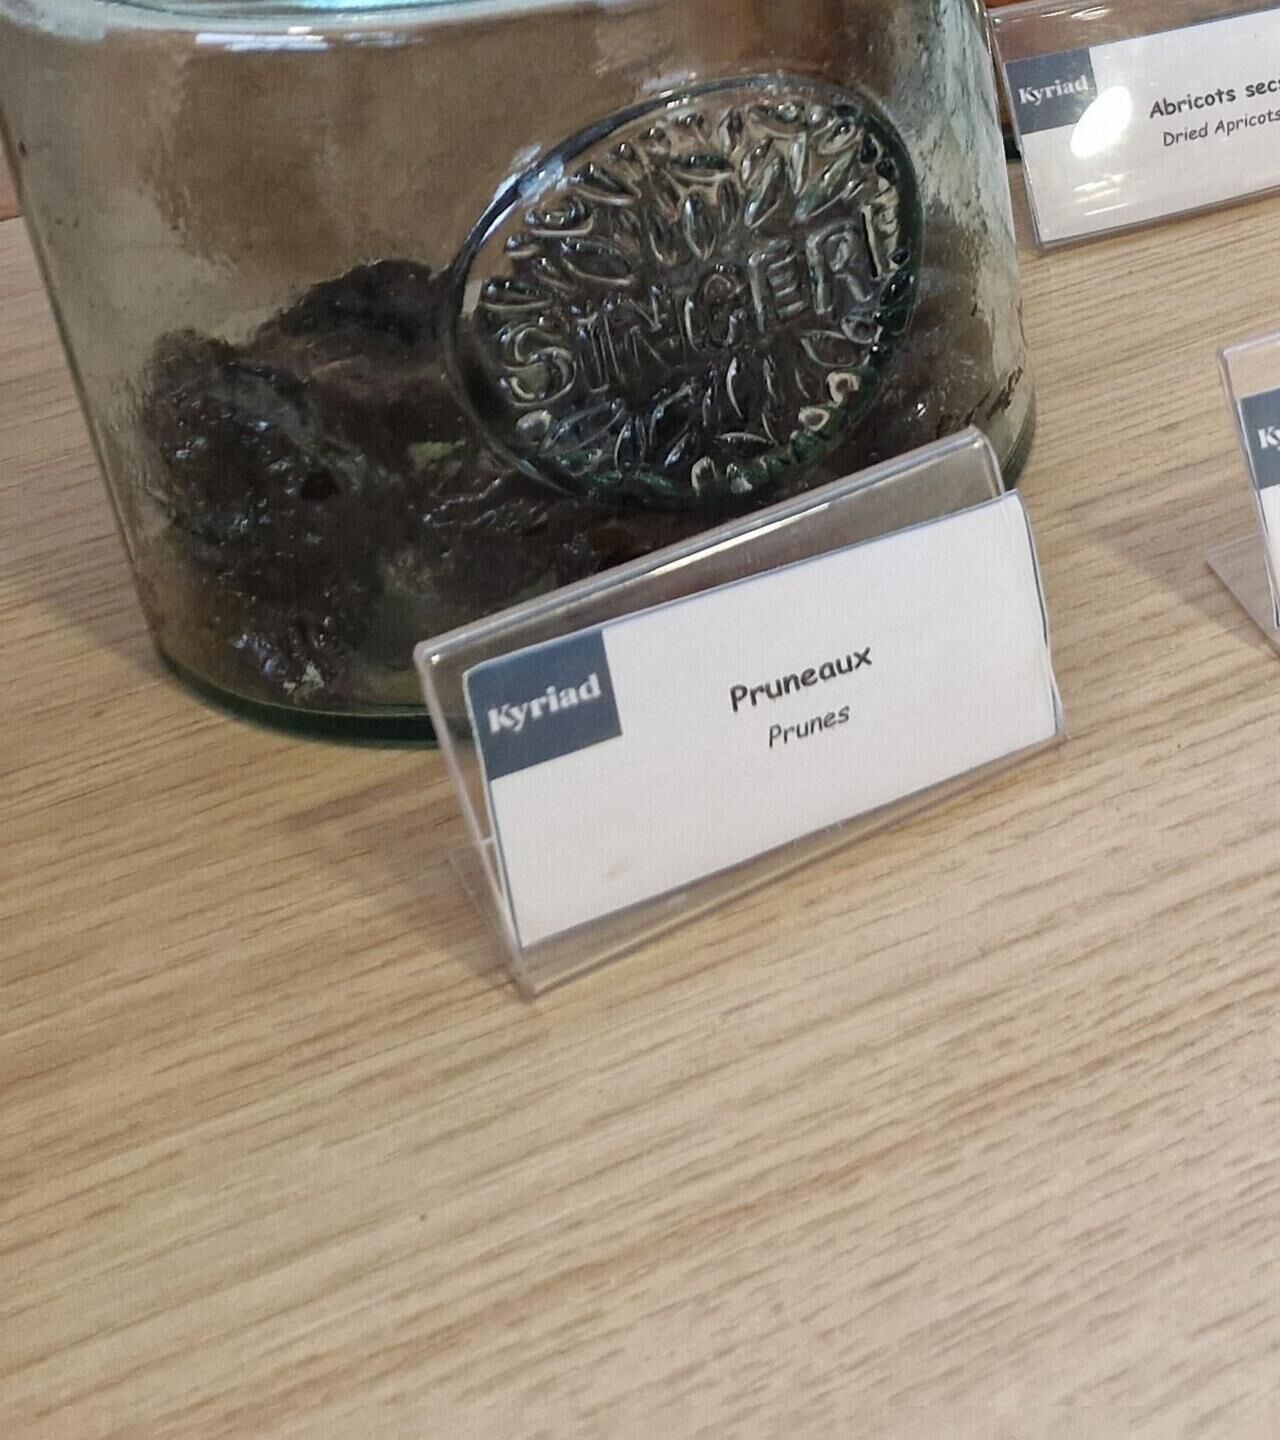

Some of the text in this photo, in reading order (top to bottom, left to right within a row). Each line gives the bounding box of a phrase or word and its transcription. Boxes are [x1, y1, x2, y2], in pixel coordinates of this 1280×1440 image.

[1017, 74, 1090, 106] Kyriad
[1148, 88, 1237, 119] Abricots
[1162, 122, 1208, 148] Dried
[729, 646, 872, 712] Pruneaux
[487, 673, 602, 735] Kyriad
[766, 703, 851, 749] Prunes
